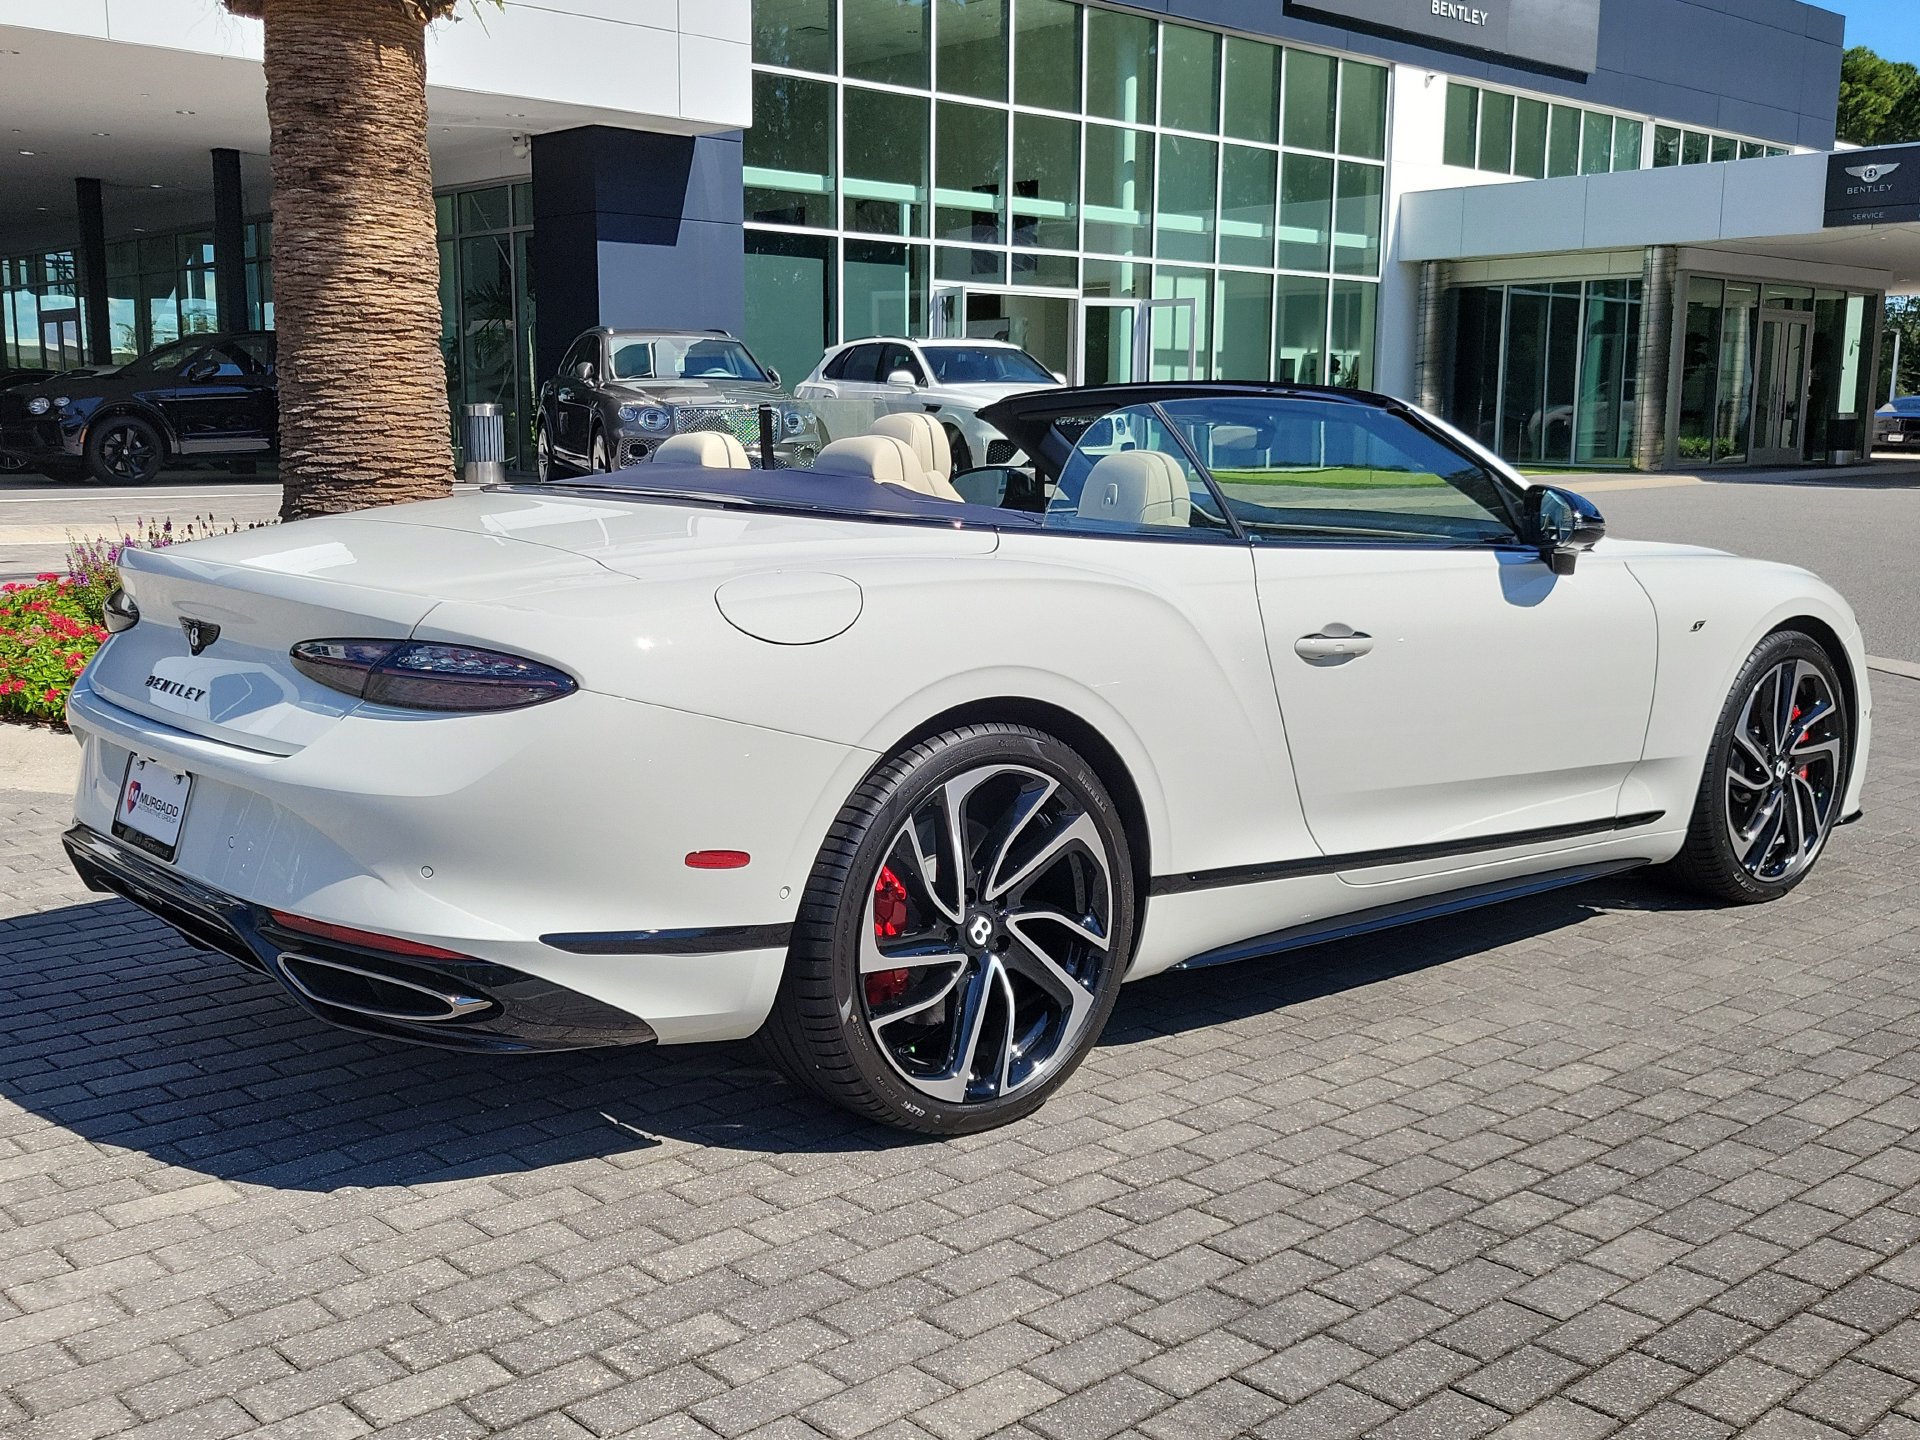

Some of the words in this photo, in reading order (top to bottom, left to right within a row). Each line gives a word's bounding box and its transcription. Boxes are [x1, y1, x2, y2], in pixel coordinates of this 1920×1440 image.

[1431, 0, 1488, 26] BENTLEY
[1846, 183, 1893, 195] BENTLEY
[1852, 212, 1885, 220] SERVICE
[145, 673, 206, 702] BENTLEY
[139, 791, 179, 818] MURGADO
